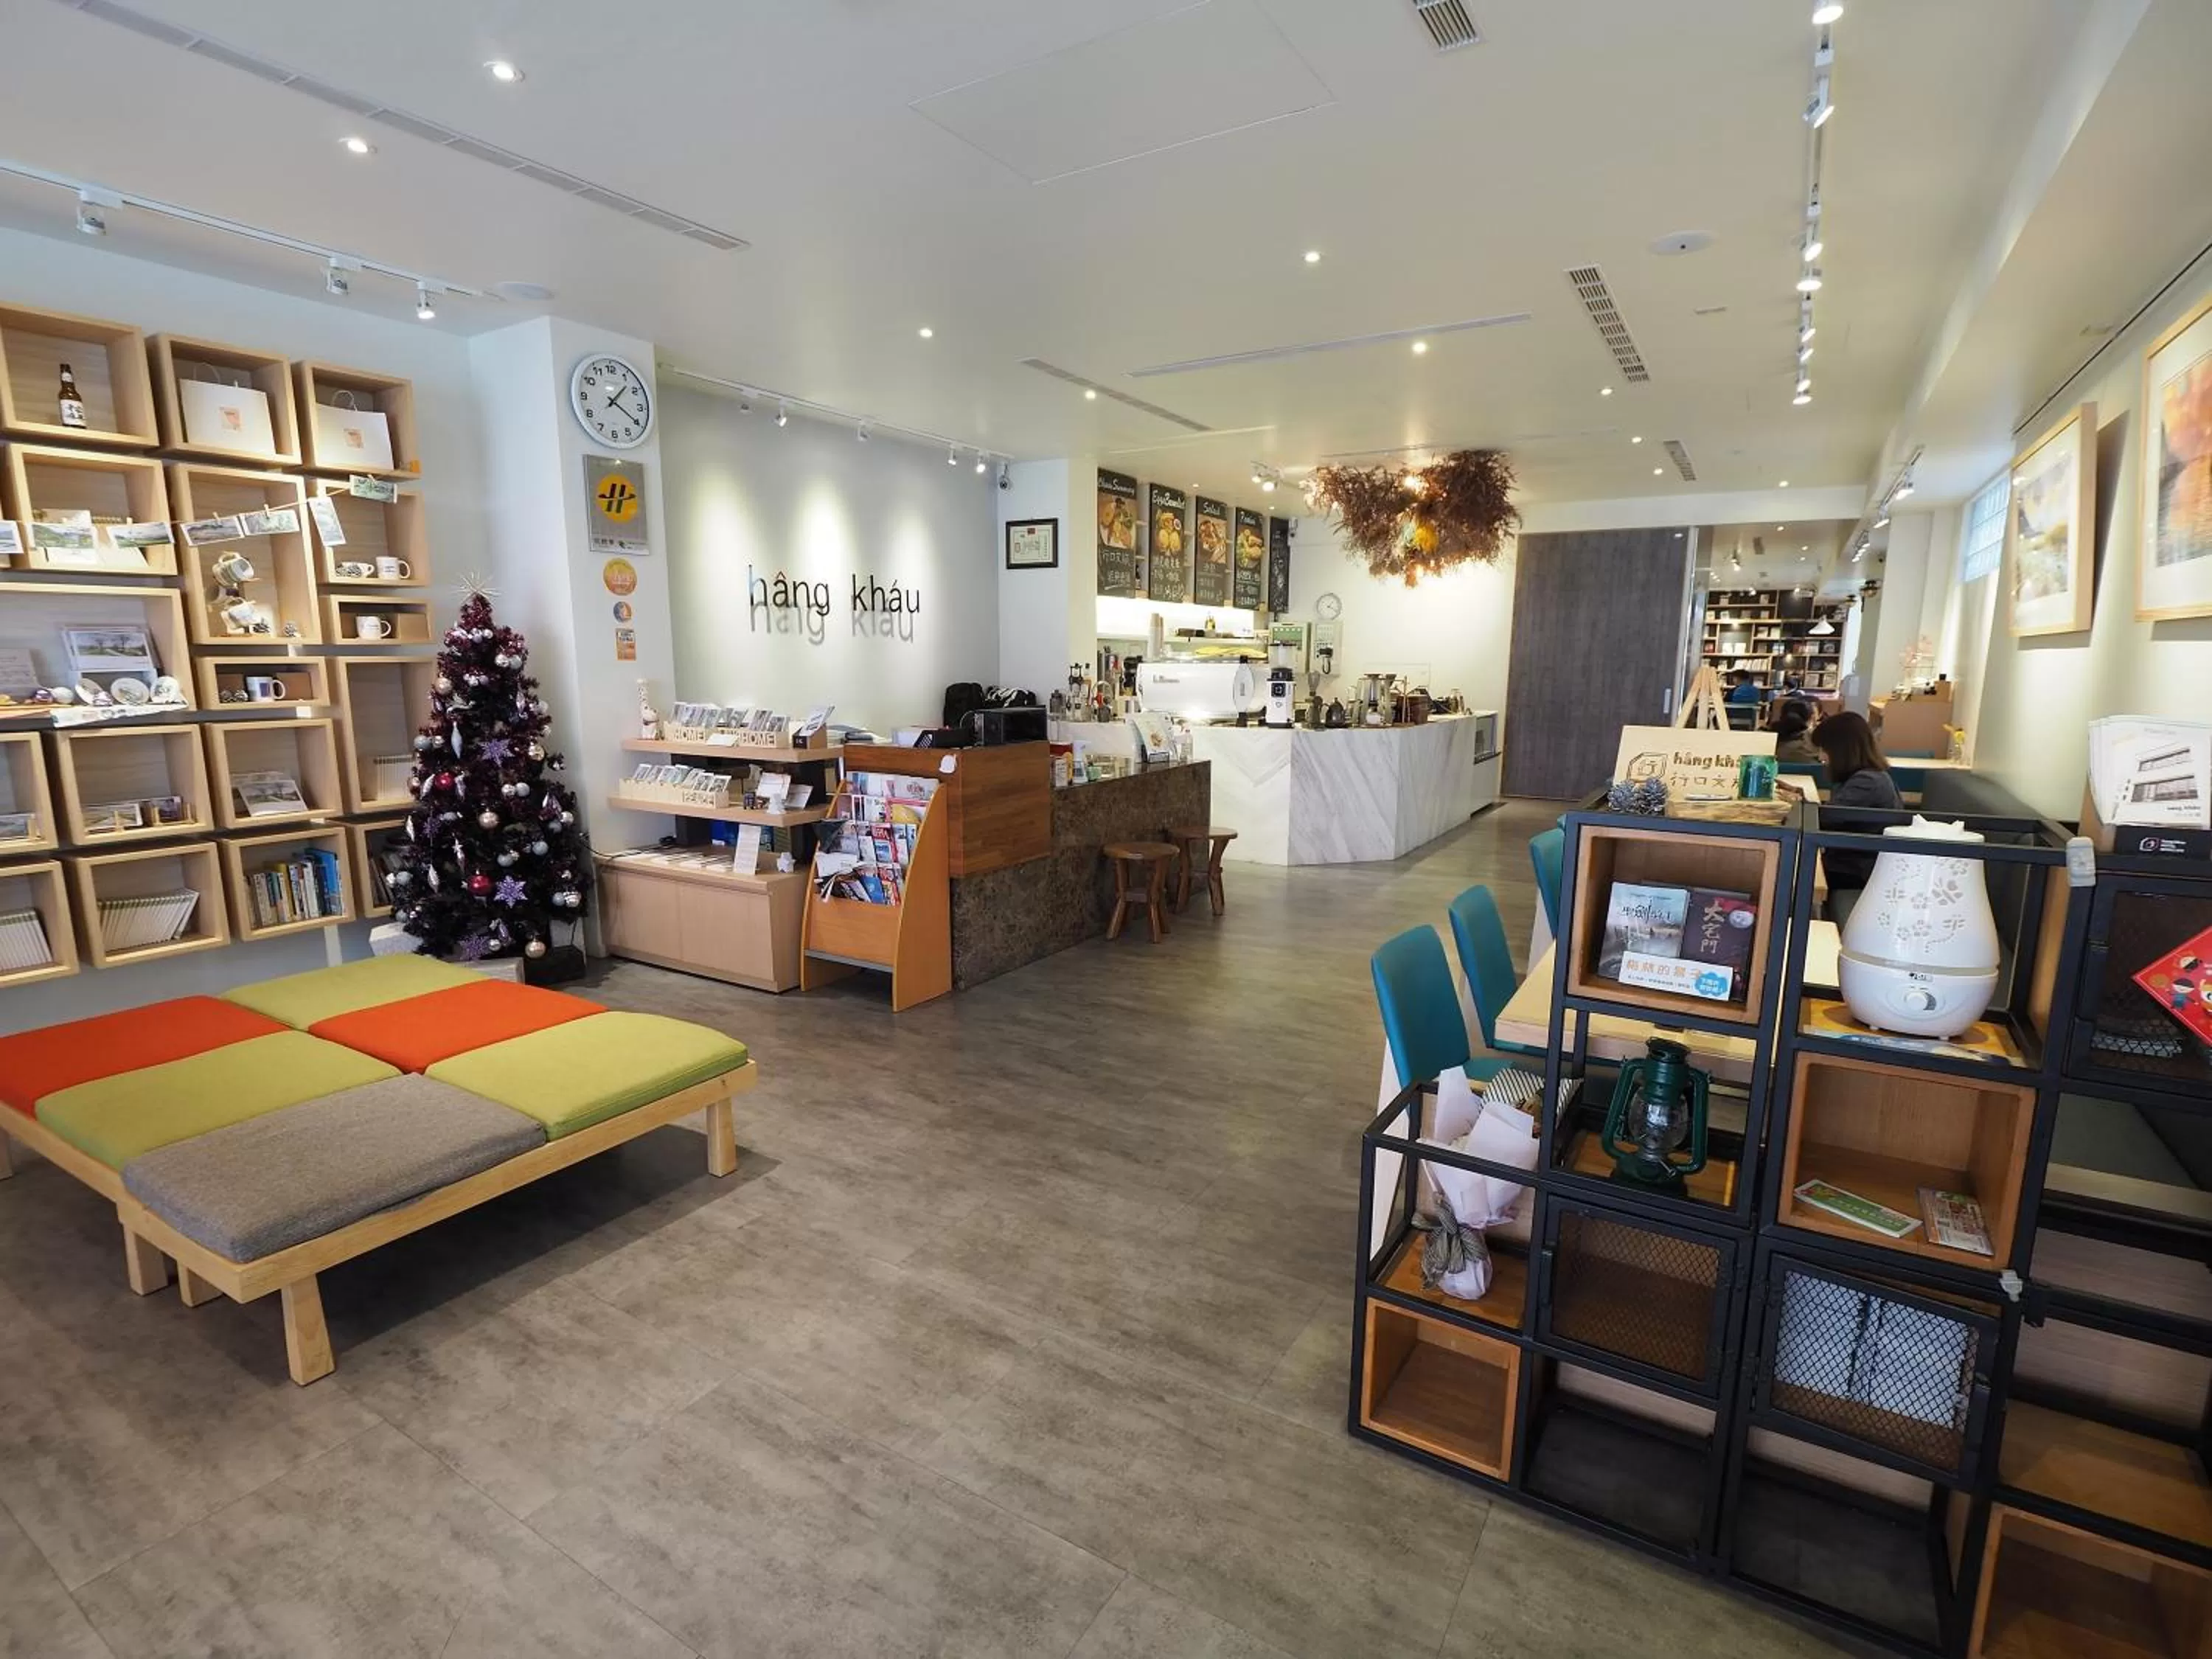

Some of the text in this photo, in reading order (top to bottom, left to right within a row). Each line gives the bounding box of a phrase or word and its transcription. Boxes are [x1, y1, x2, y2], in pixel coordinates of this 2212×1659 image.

[592, 366, 603, 376] 11
[605, 365, 617, 375] 12
[583, 377, 597, 386] 10
[622, 373, 627, 382] 1
[631, 386, 639, 396] 2
[580, 392, 588, 400] 9
[636, 403, 644, 412] 3
[586, 409, 594, 418] 8
[597, 422, 604, 431] 7
[611, 430, 619, 439] 6
[625, 427, 632, 437] 5
[748, 563, 920, 616] hâng kháu
[1673, 751, 1741, 770] hâng kh
[1699, 900, 1725, 954] 大宅門
